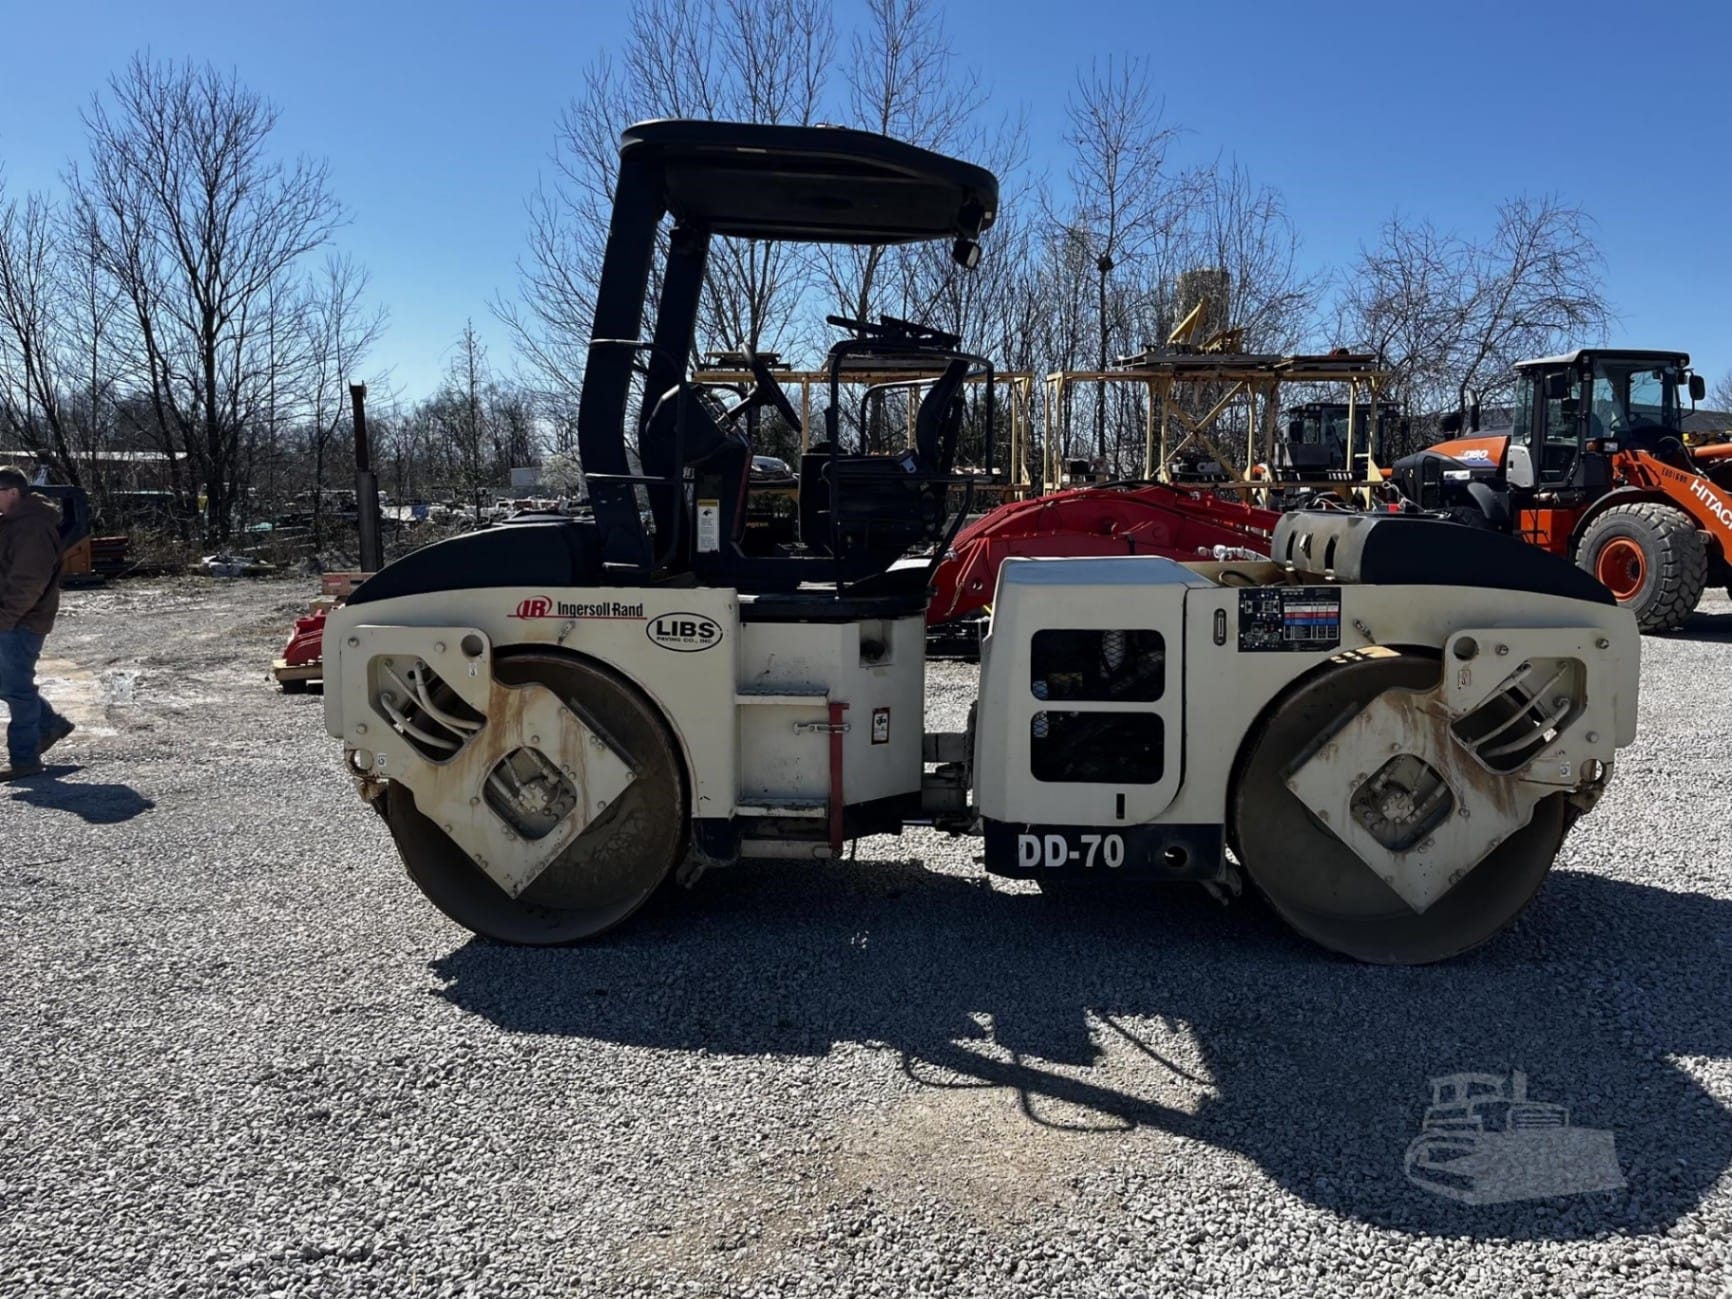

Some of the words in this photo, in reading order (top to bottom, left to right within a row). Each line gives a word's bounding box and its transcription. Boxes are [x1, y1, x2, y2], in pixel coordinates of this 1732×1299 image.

[1690, 479, 1732, 530] HITAC
[521, 598, 548, 618] IR
[656, 620, 715, 638] LIBS
[1018, 834, 1125, 868] DD-70
